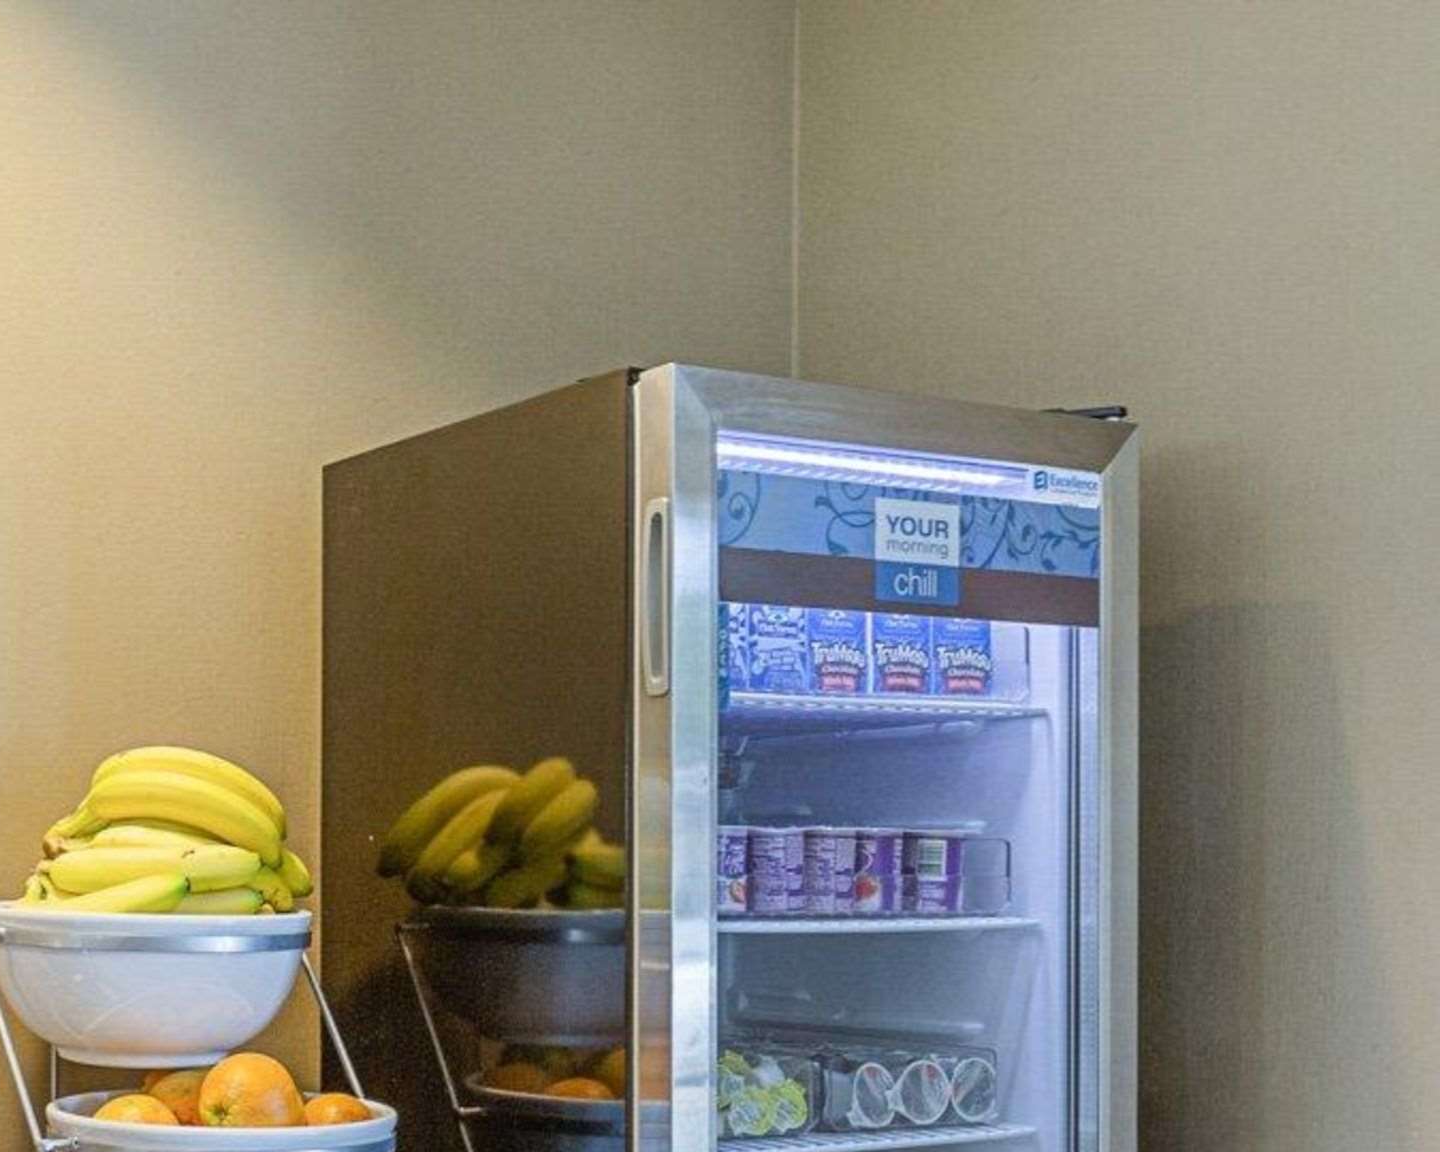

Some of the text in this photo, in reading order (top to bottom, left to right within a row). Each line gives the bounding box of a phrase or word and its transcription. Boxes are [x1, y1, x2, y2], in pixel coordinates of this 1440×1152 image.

[886, 514, 949, 539] YOUR
[886, 540, 949, 559] morning
[894, 568, 938, 597] chill
